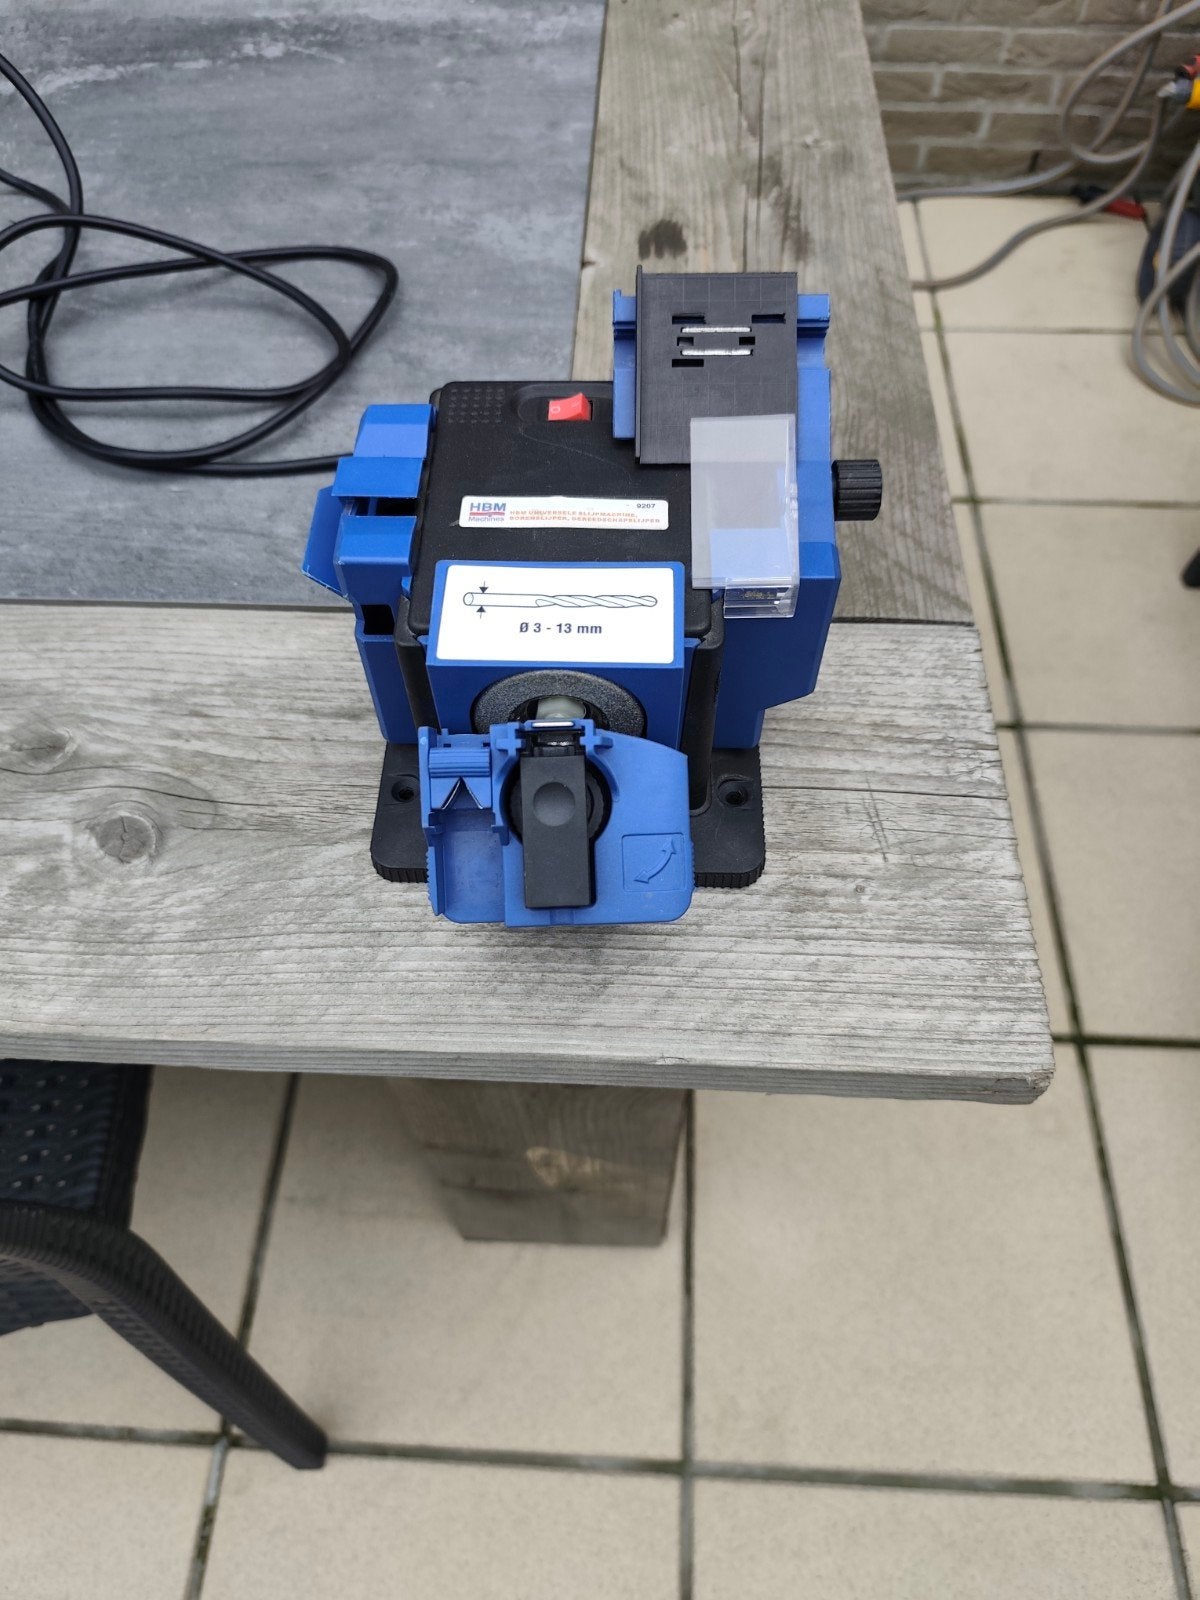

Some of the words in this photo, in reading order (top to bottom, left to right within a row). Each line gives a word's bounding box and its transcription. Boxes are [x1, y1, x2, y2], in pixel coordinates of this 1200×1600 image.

[469, 502, 507, 512] HBM
[533, 622, 542, 633] 3
[556, 623, 573, 634] 13
[577, 625, 603, 634] mm
